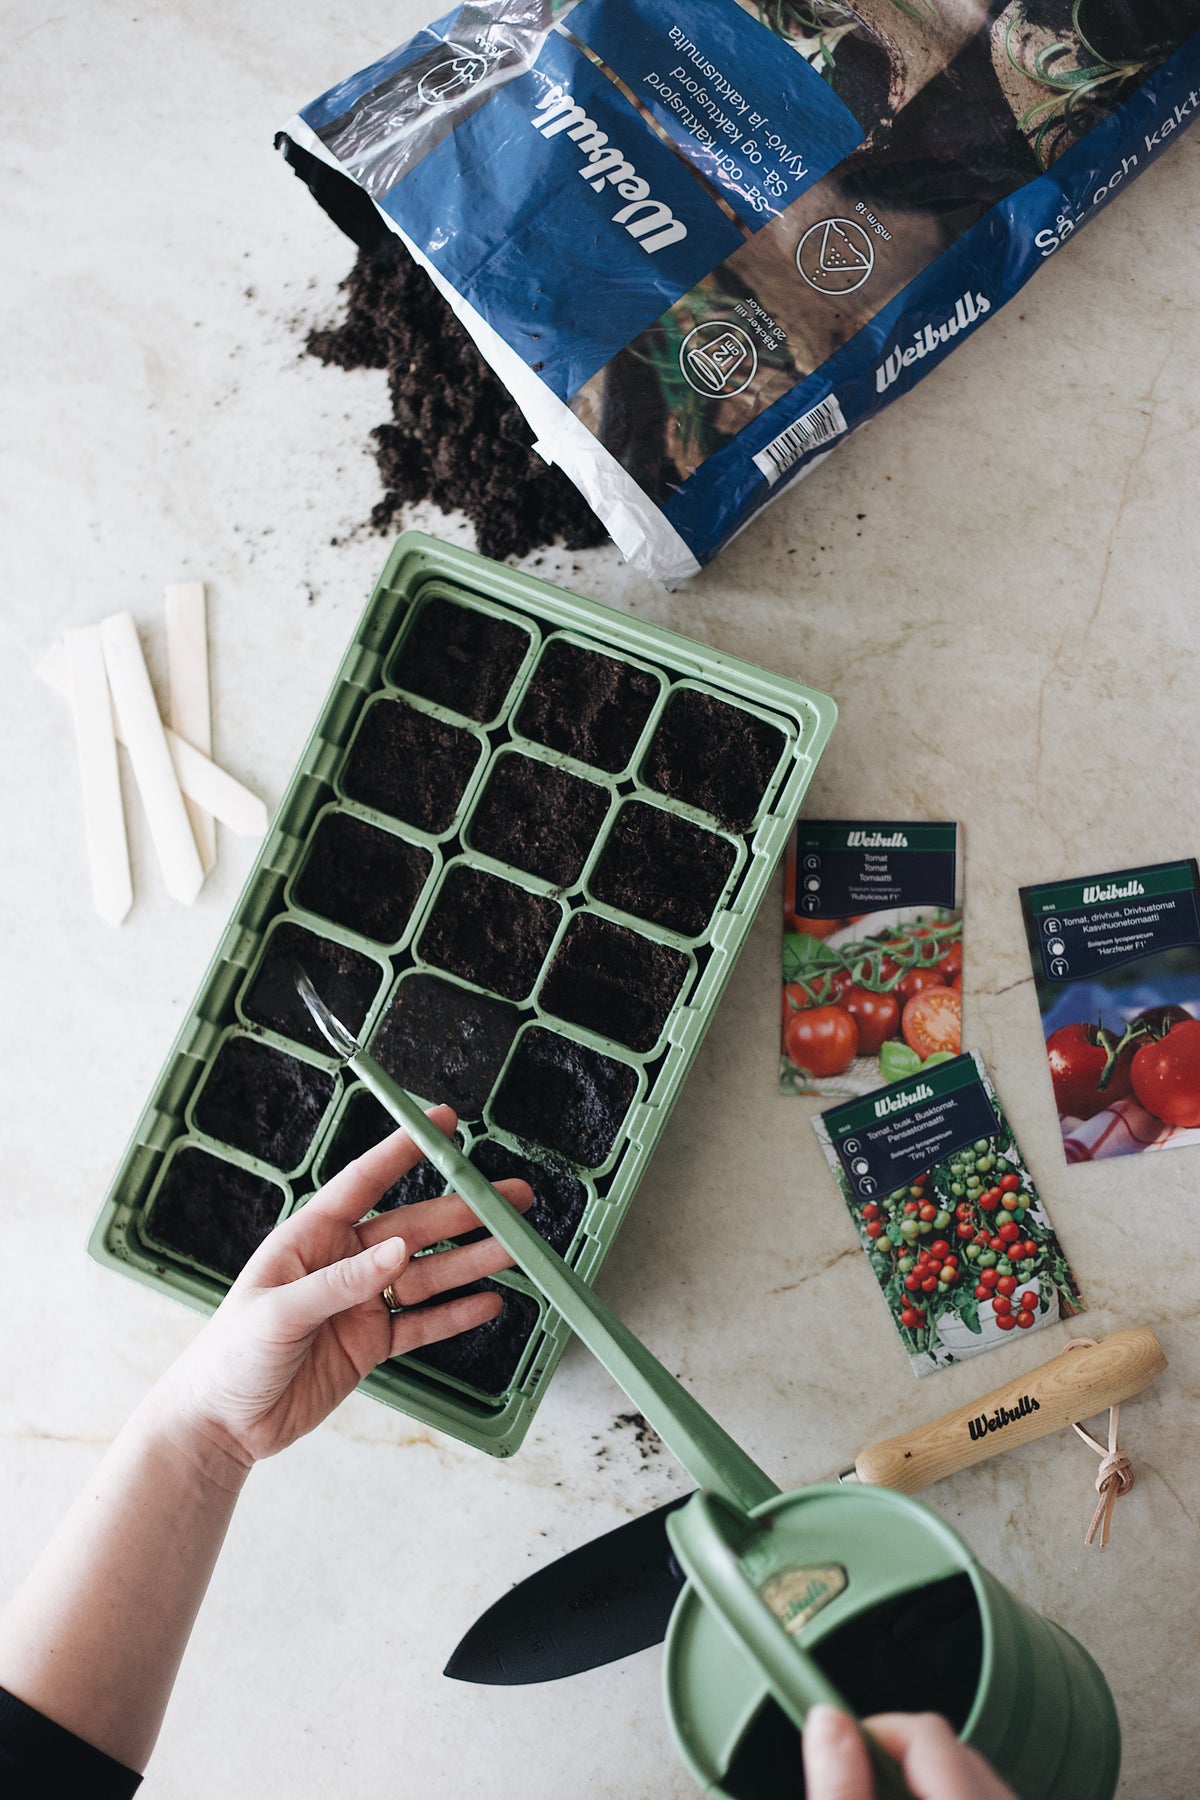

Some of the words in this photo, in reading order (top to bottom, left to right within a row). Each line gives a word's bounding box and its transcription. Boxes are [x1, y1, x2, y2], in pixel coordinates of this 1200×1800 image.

[668, 25, 751, 116] kaktusmulta
[643, 72, 717, 152] kaktusjord
[669, 66, 743, 144] kaktusjord
[748, 111, 769, 132] ja
[714, 148, 743, 180] och
[741, 139, 762, 164] og
[764, 130, 808, 181] Kylvö-
[531, 85, 688, 254] Weibulls
[762, 167, 788, 197] Så-
[1034, 211, 1085, 257] Så-
[1093, 154, 1138, 205] och
[1144, 87, 1200, 152] kakt
[743, 183, 769, 212] Så-
[855, 202, 868, 215] 18
[866, 213, 892, 241] mS/m
[734, 304, 748, 317] till
[746, 298, 776, 328] krukor
[747, 317, 778, 351] Räcker
[772, 327, 787, 341] 20
[876, 290, 991, 393] Weibulls
[713, 345, 733, 368] 12
[724, 340, 740, 356] cm
[847, 831, 908, 847] Weibulls
[807, 858, 817, 868] G
[864, 854, 888, 862] Tomat
[864, 864, 888, 872] Tomat
[859, 874, 892, 882] Tomaatti
[1082, 880, 1145, 904] Weibulls
[1049, 921, 1058, 932] E
[1063, 915, 1090, 927] Tomat,
[1124, 901, 1176, 916] Drivhustomat
[1083, 914, 1160, 933] Kasvihuonetomaatti
[874, 1083, 934, 1118] Weibulls
[866, 1126, 893, 1141] Tomat,
[914, 1099, 958, 1121] Busktomat,
[887, 1115, 945, 1143] Pensastomaatti
[847, 1142, 858, 1153] C
[968, 1395, 1041, 1441] Weibulls
